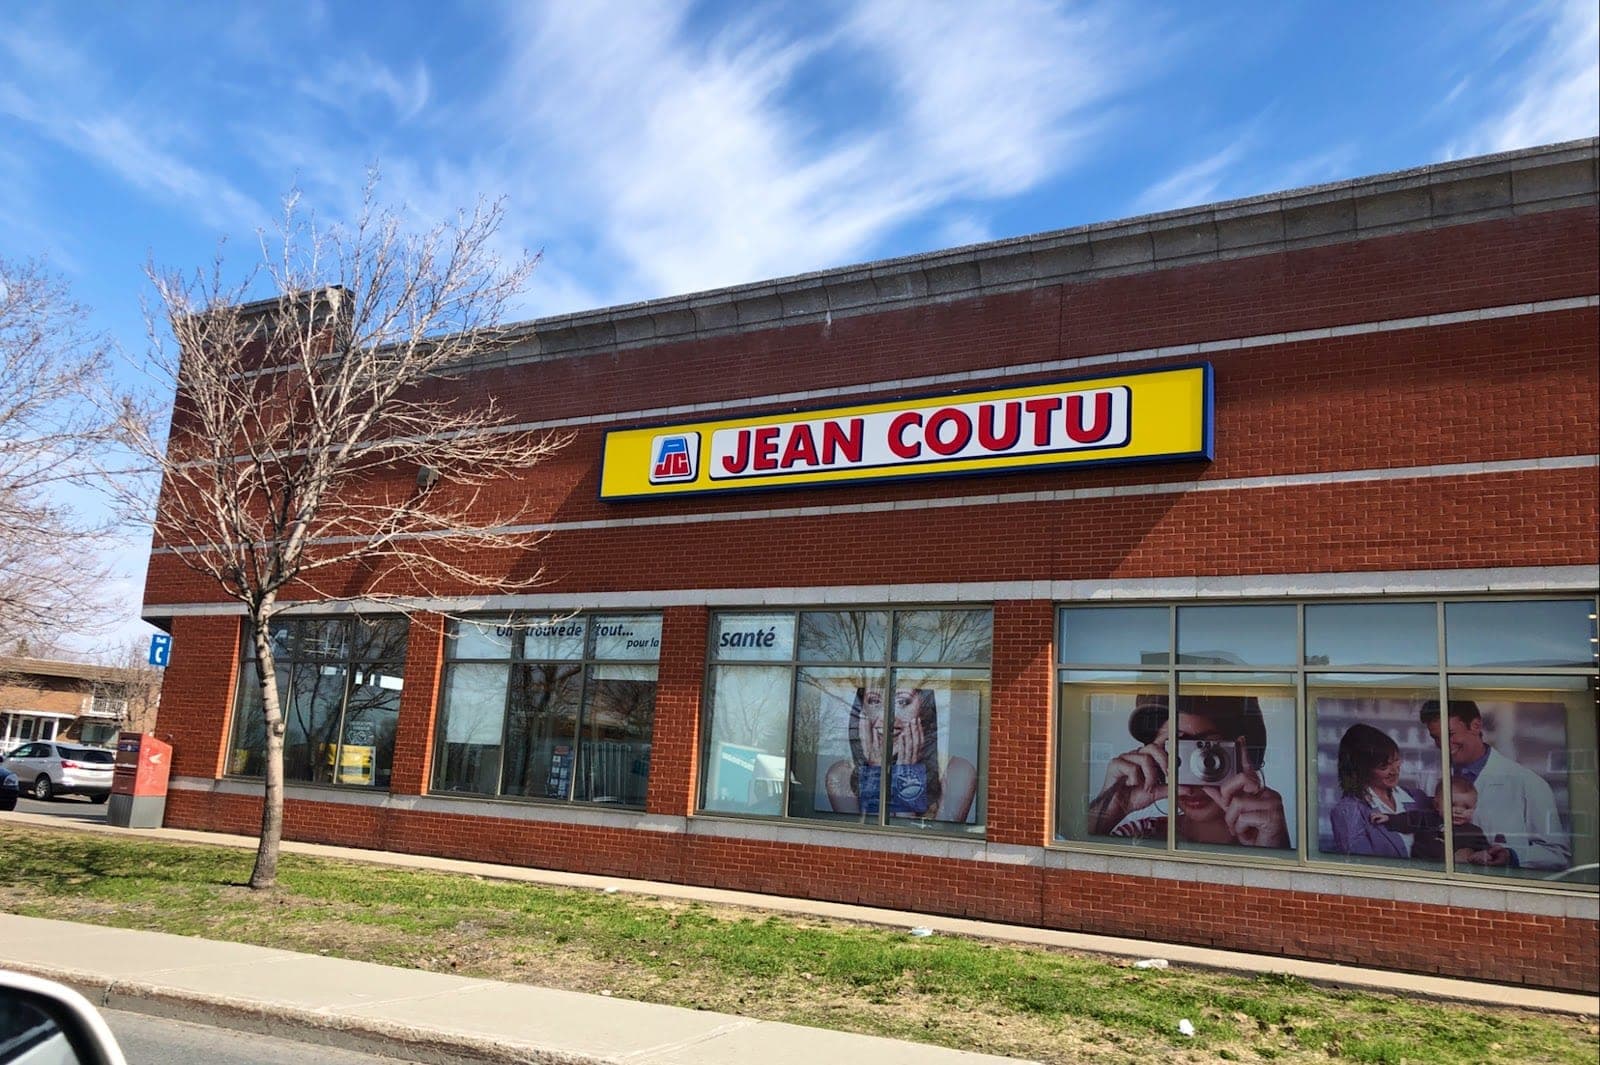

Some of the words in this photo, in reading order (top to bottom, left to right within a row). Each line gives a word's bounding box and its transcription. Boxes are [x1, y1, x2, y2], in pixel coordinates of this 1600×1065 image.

[722, 418, 864, 474] JEAN
[887, 391, 1113, 460] COUTU
[627, 638, 649, 650] pour
[650, 637, 660, 648] la
[719, 626, 776, 648] santé
